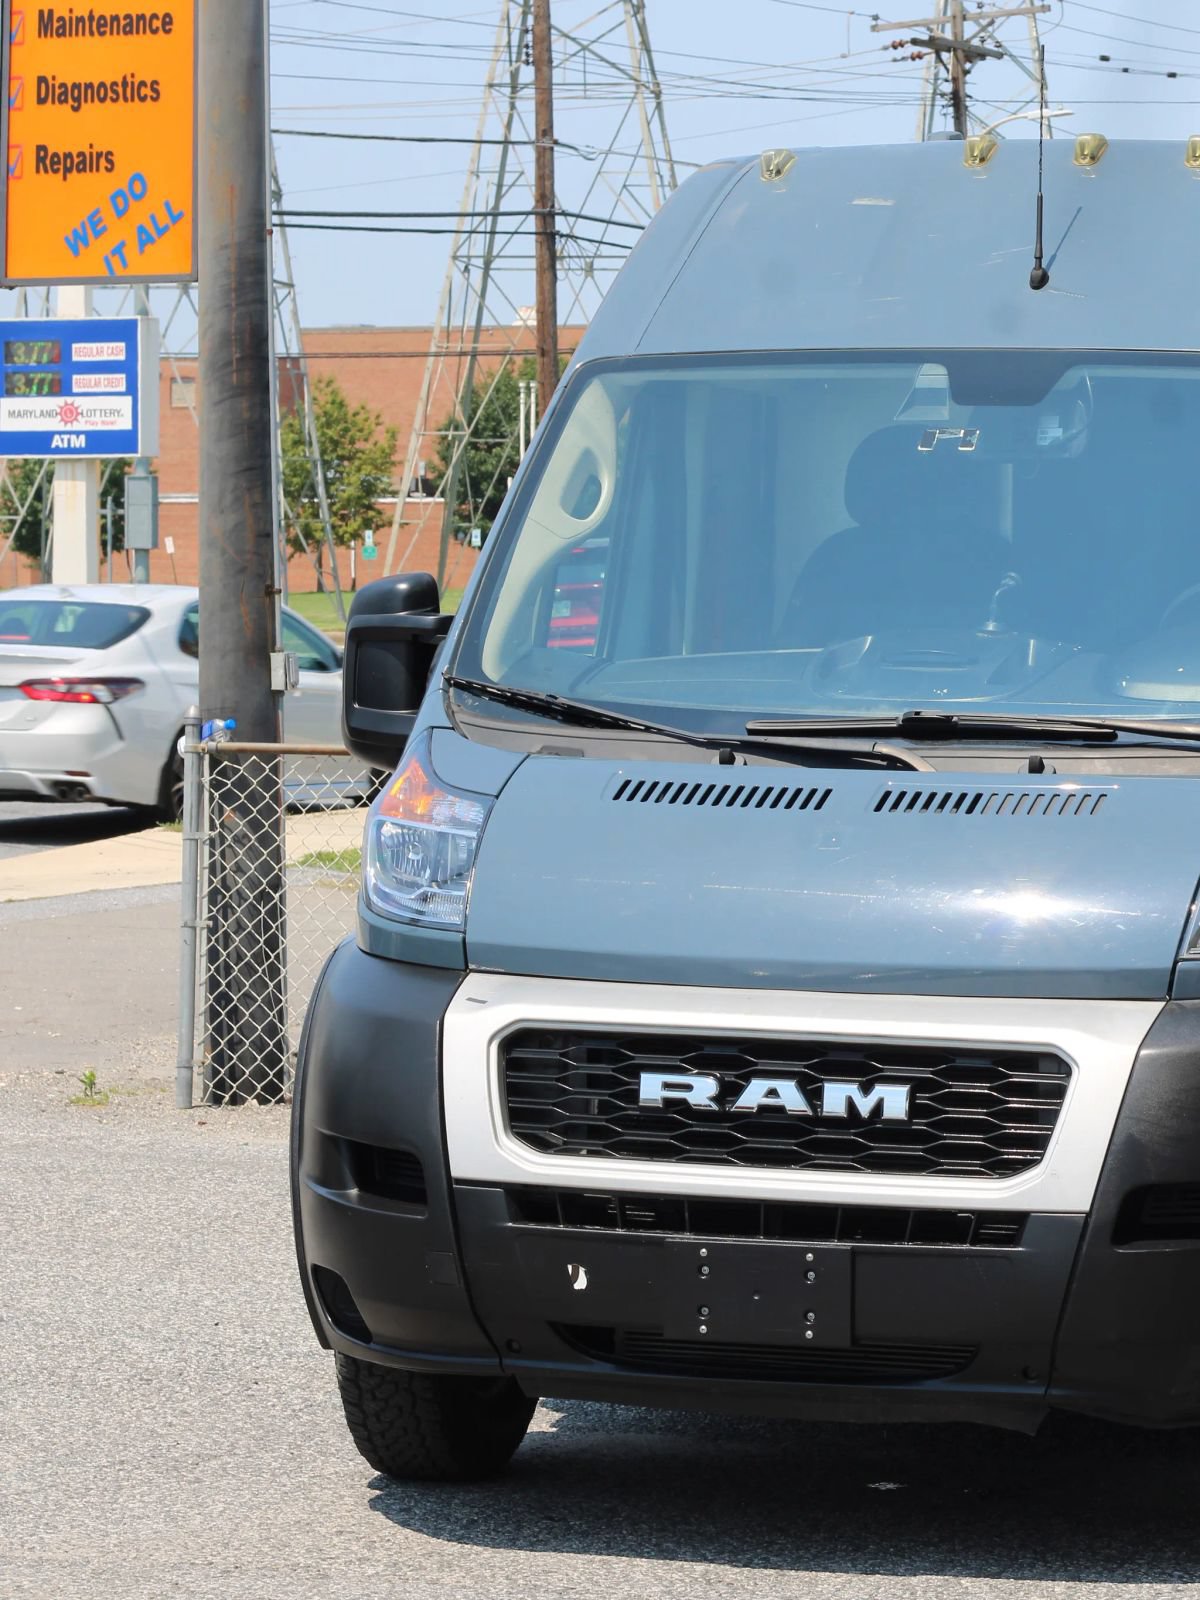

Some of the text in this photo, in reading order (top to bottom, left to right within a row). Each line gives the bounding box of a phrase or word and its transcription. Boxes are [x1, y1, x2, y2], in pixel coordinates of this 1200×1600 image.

[37, 8, 174, 39] Maintenance
[36, 73, 161, 113] Diagnostics
[35, 143, 115, 182] Repairs
[63, 172, 148, 258] WE DO
[103, 200, 184, 277] IT ALL
[74, 344, 124, 358] REGULAR CASH
[74, 376, 124, 389] REGULAR CREDIT
[8, 408, 57, 419] MARYLAND
[51, 434, 86, 448] ATM
[638, 1071, 912, 1121] RAM
